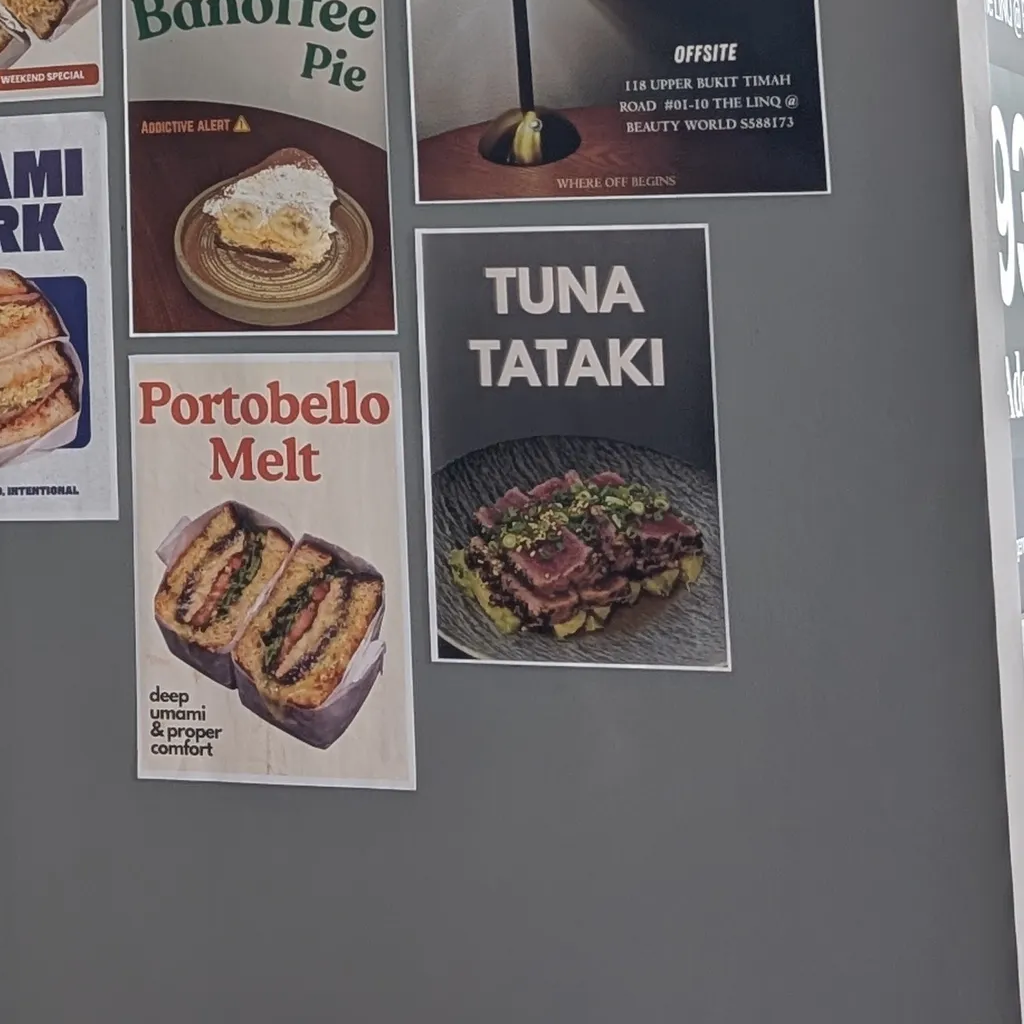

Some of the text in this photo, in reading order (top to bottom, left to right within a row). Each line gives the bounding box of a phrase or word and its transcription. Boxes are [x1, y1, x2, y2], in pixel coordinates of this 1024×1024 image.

[674, 43, 738, 64] OFFSITE
[0, 70, 85, 84] WEEKEND SPECIAL
[300, 42, 367, 92] Pie
[625, 74, 791, 92] 118 UPPER BUKIT TIMAH
[620, 94, 799, 113] ROAD #01-10 THE LINQ @
[141, 119, 231, 134] ADDICTIVE ALERT
[626, 116, 794, 133] BEAUTY WORLD S588173
[556, 176, 676, 189] WHERE OFF BEGINS
[484, 265, 645, 315] TUNA
[468, 338, 665, 387] TATAKI
[138, 379, 390, 425] Portobello
[209, 436, 322, 482] Melt
[149, 685, 189, 707] deep
[150, 705, 206, 721] umami
[150, 721, 223, 743] & proper
[151, 738, 213, 757] comfort
